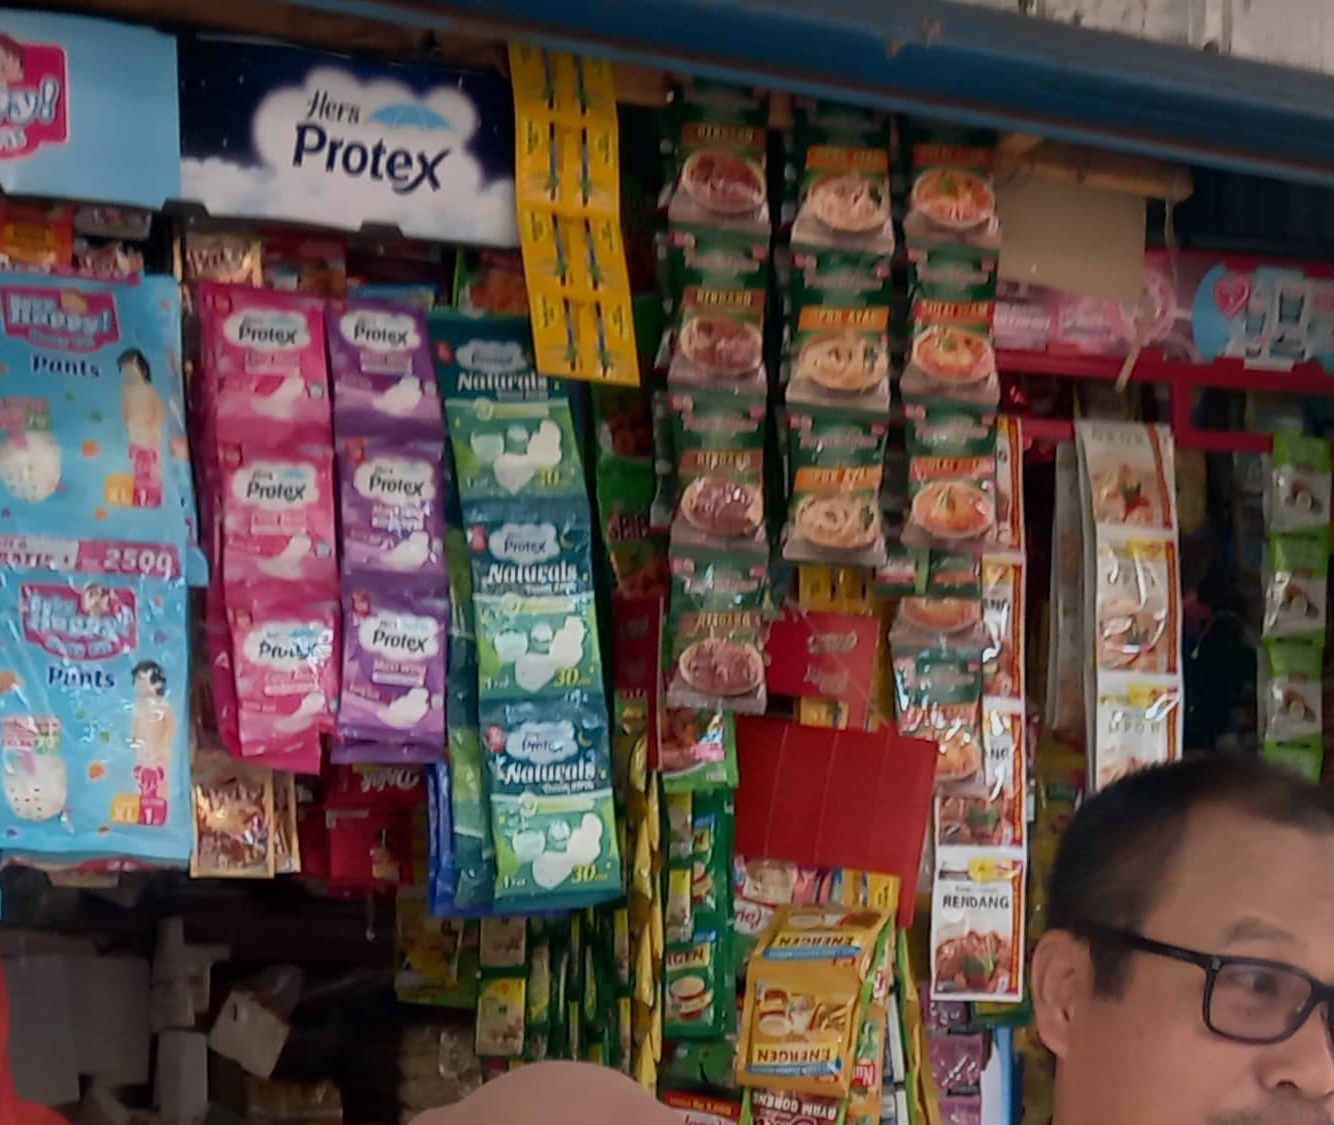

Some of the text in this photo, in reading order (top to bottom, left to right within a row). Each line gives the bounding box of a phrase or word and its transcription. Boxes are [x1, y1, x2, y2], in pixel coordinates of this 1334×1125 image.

[308, 91, 360, 125] Hera
[293, 123, 452, 192] Protex
[238, 326, 298, 345] Protex
[354, 326, 408, 346] Protex
[31, 353, 101, 378] Pants
[457, 373, 547, 391] Naturals
[247, 481, 307, 502] Protex
[369, 474, 424, 497] Protex
[503, 538, 546, 555] Protex
[487, 561, 577, 586] Naturals
[371, 629, 428, 653] Protex
[48, 665, 115, 690] Pants
[554, 667, 579, 686] 30
[503, 761, 595, 785] Naturals
[571, 865, 595, 884] 30
[941, 893, 1010, 910] RENDANG
[757, 1049, 831, 1063] ENERGEN
[800, 1102, 838, 1119] AYAM
